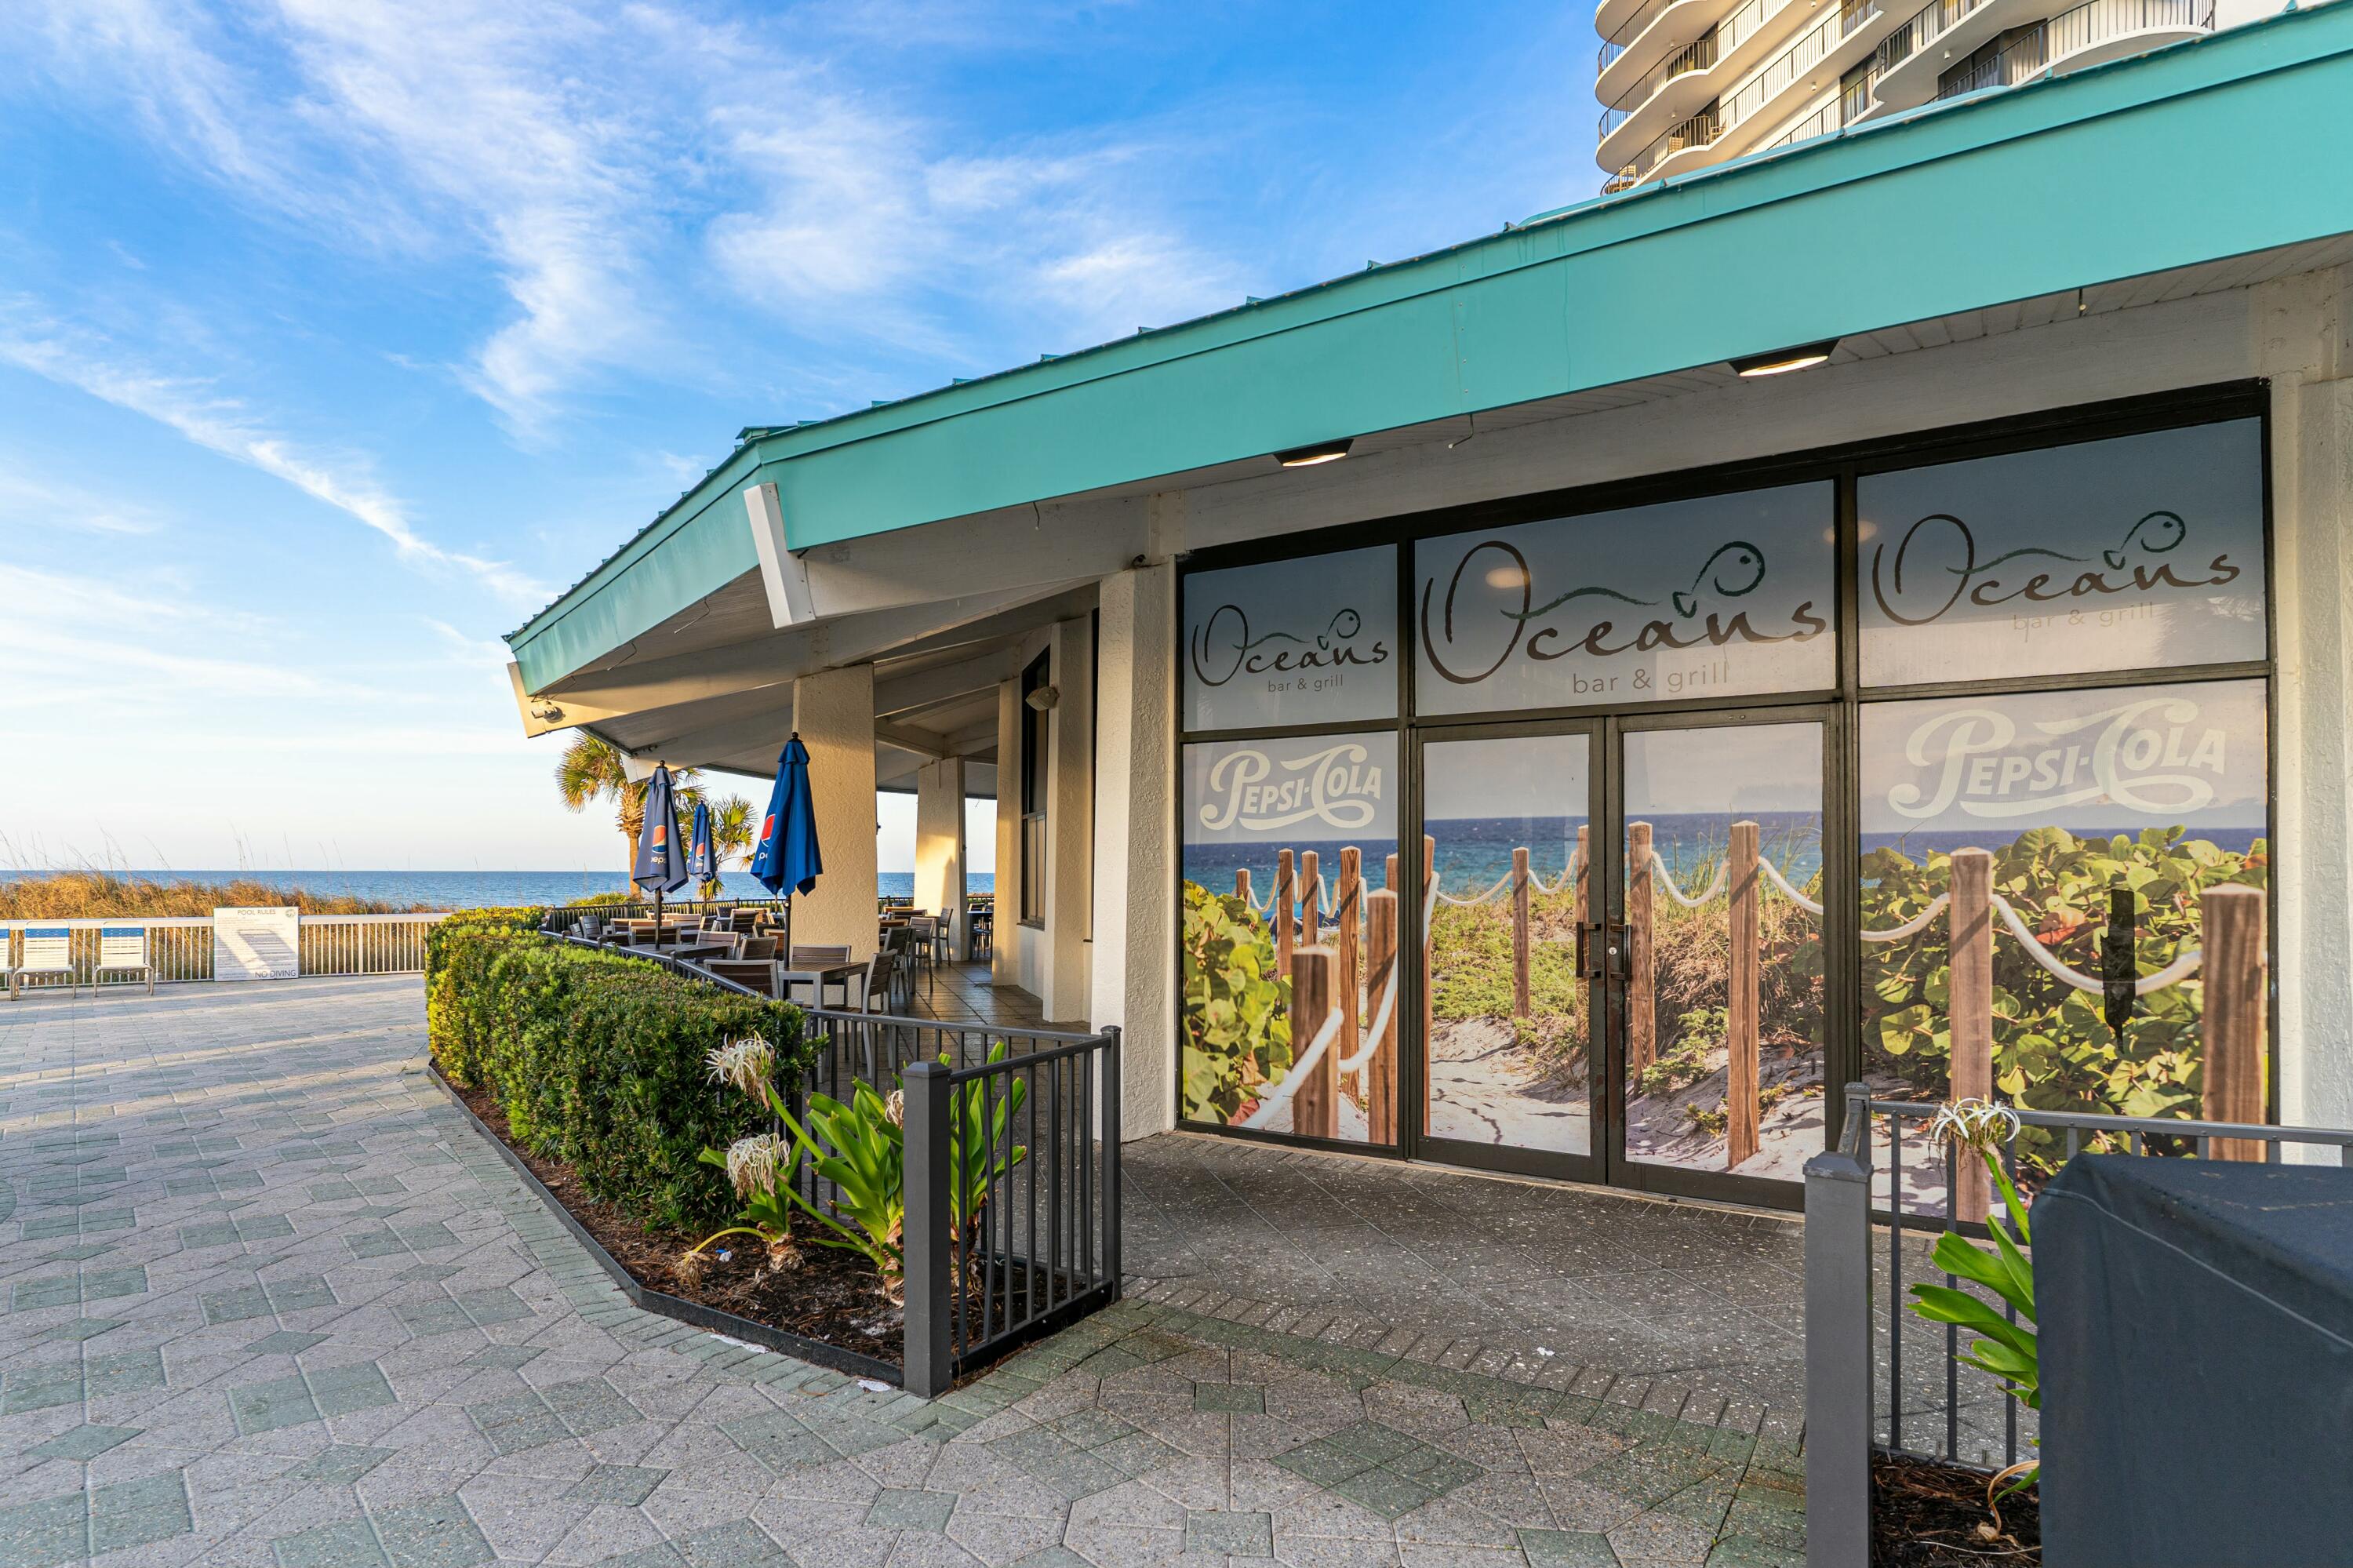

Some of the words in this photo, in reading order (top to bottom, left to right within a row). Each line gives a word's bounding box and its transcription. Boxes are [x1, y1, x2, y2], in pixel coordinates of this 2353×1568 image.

[1872, 514, 2241, 626] Oceans
[1420, 540, 1827, 685] Oceans
[2013, 614, 2055, 630] bar
[2067, 609, 2085, 626] &
[2099, 602, 2153, 628] grill
[1192, 604, 1388, 687] Oceans
[1267, 680, 1291, 693] bar
[1297, 678, 1307, 689] &
[1314, 674, 1344, 692] grill
[1573, 673, 1619, 694] bar
[1632, 668, 1651, 689] &
[1667, 660, 1727, 693] grill
